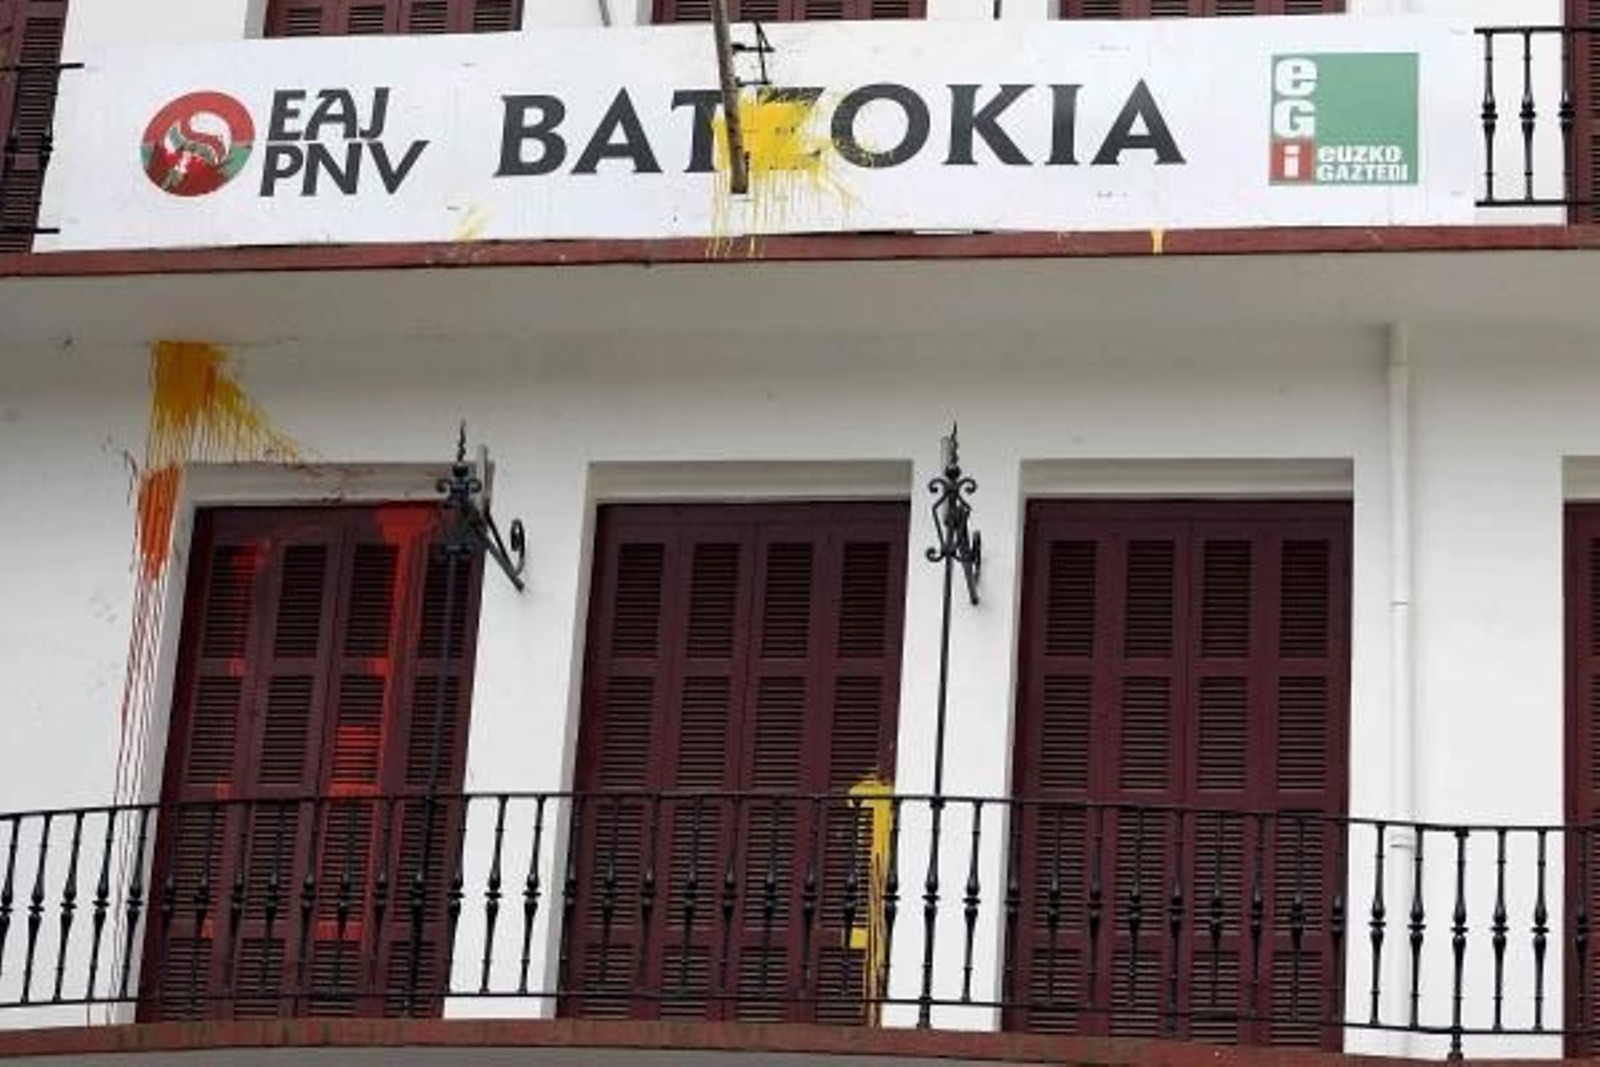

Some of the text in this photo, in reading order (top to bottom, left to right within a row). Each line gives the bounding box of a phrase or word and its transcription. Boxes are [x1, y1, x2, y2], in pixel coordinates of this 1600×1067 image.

[264, 86, 391, 141] EAJ
[259, 140, 430, 197] PNV
[1319, 164, 1408, 181] GAZTEDI
